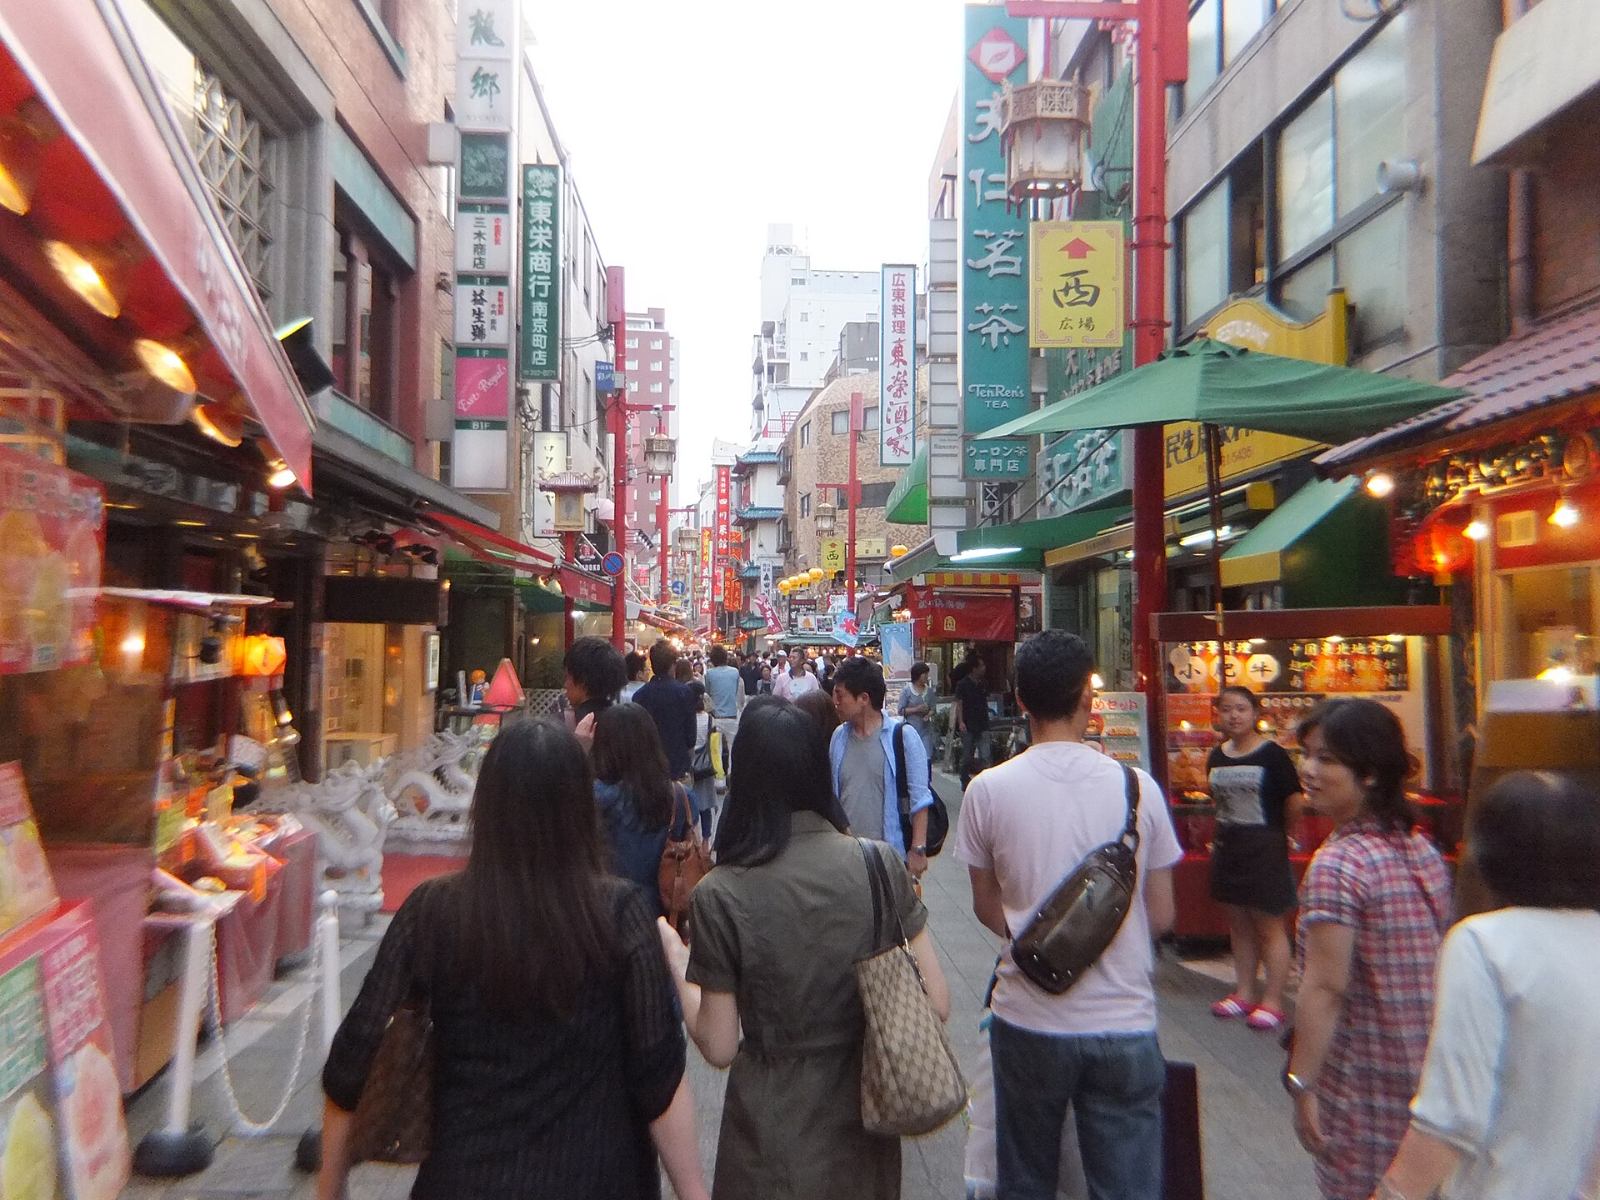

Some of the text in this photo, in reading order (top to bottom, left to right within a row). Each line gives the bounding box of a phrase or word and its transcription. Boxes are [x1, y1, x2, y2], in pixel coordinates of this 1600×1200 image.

[477, 205, 490, 214] 1F
[473, 217, 487, 269] 三木商店
[476, 277, 490, 286] 1F
[1053, 269, 1101, 309] 西
[892, 272, 906, 335] 広東料理
[1059, 317, 1096, 332] 広場
[532, 301, 548, 366] 南京町店
[476, 349, 489, 357] 1F
[985, 401, 1009, 409] TEA
[472, 421, 490, 430] B1F
[967, 446, 1028, 457] ウーロン茶
